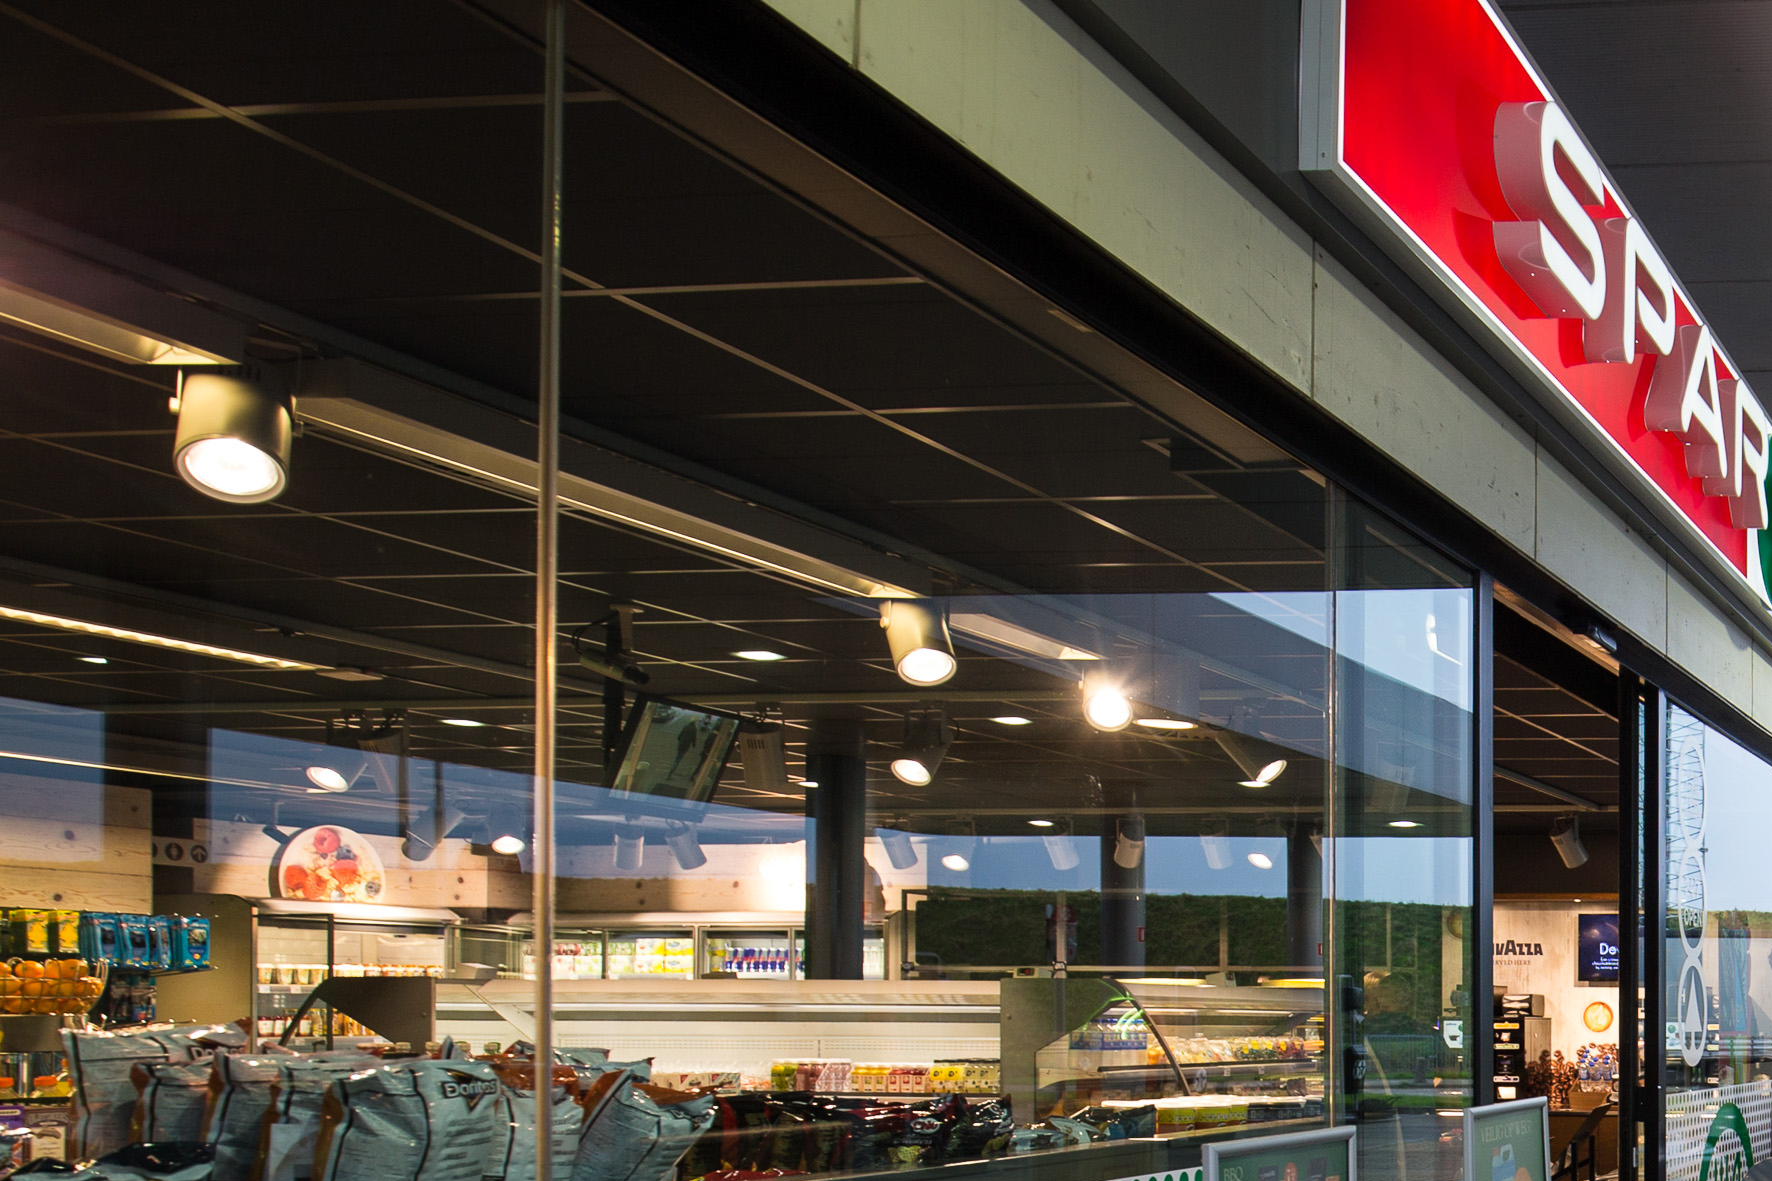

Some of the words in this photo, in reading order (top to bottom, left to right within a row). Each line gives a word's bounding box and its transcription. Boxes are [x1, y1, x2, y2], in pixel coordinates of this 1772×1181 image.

[1500, 101, 1768, 530] SPAR
[1492, 940, 1544, 956] VAZZA
[1599, 942, 1619, 955] De
[443, 1081, 497, 1098] Doritos
